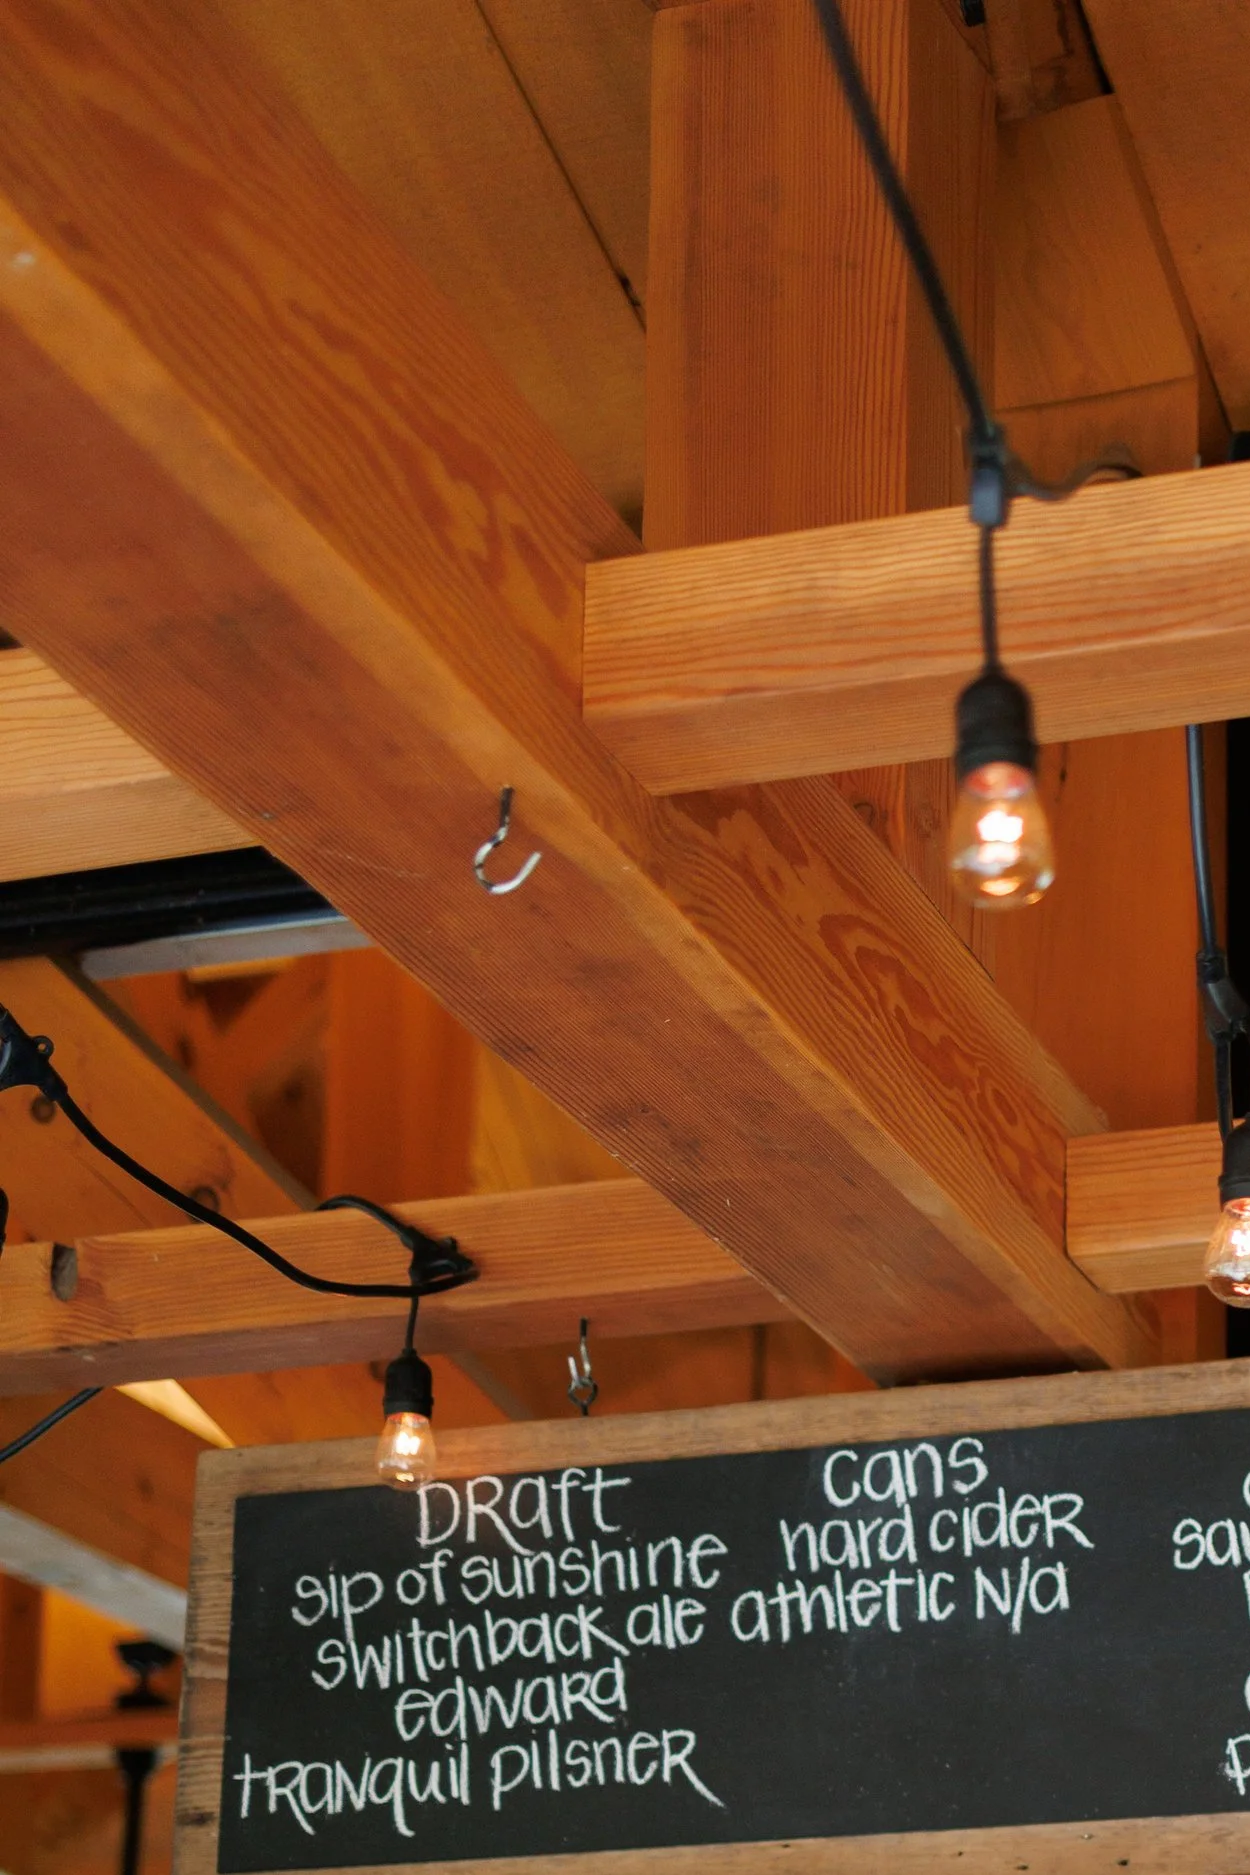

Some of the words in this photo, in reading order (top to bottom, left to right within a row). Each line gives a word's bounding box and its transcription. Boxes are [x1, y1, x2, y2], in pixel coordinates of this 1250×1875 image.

[823, 1436, 989, 1509] cans
[780, 1502, 918, 1572] hard
[291, 1564, 384, 1645] sip
[396, 1548, 454, 1606] of
[460, 1532, 729, 1605] sunshine
[731, 1566, 956, 1644] athletic
[311, 1603, 630, 1691] switchback
[626, 1594, 707, 1651] ale
